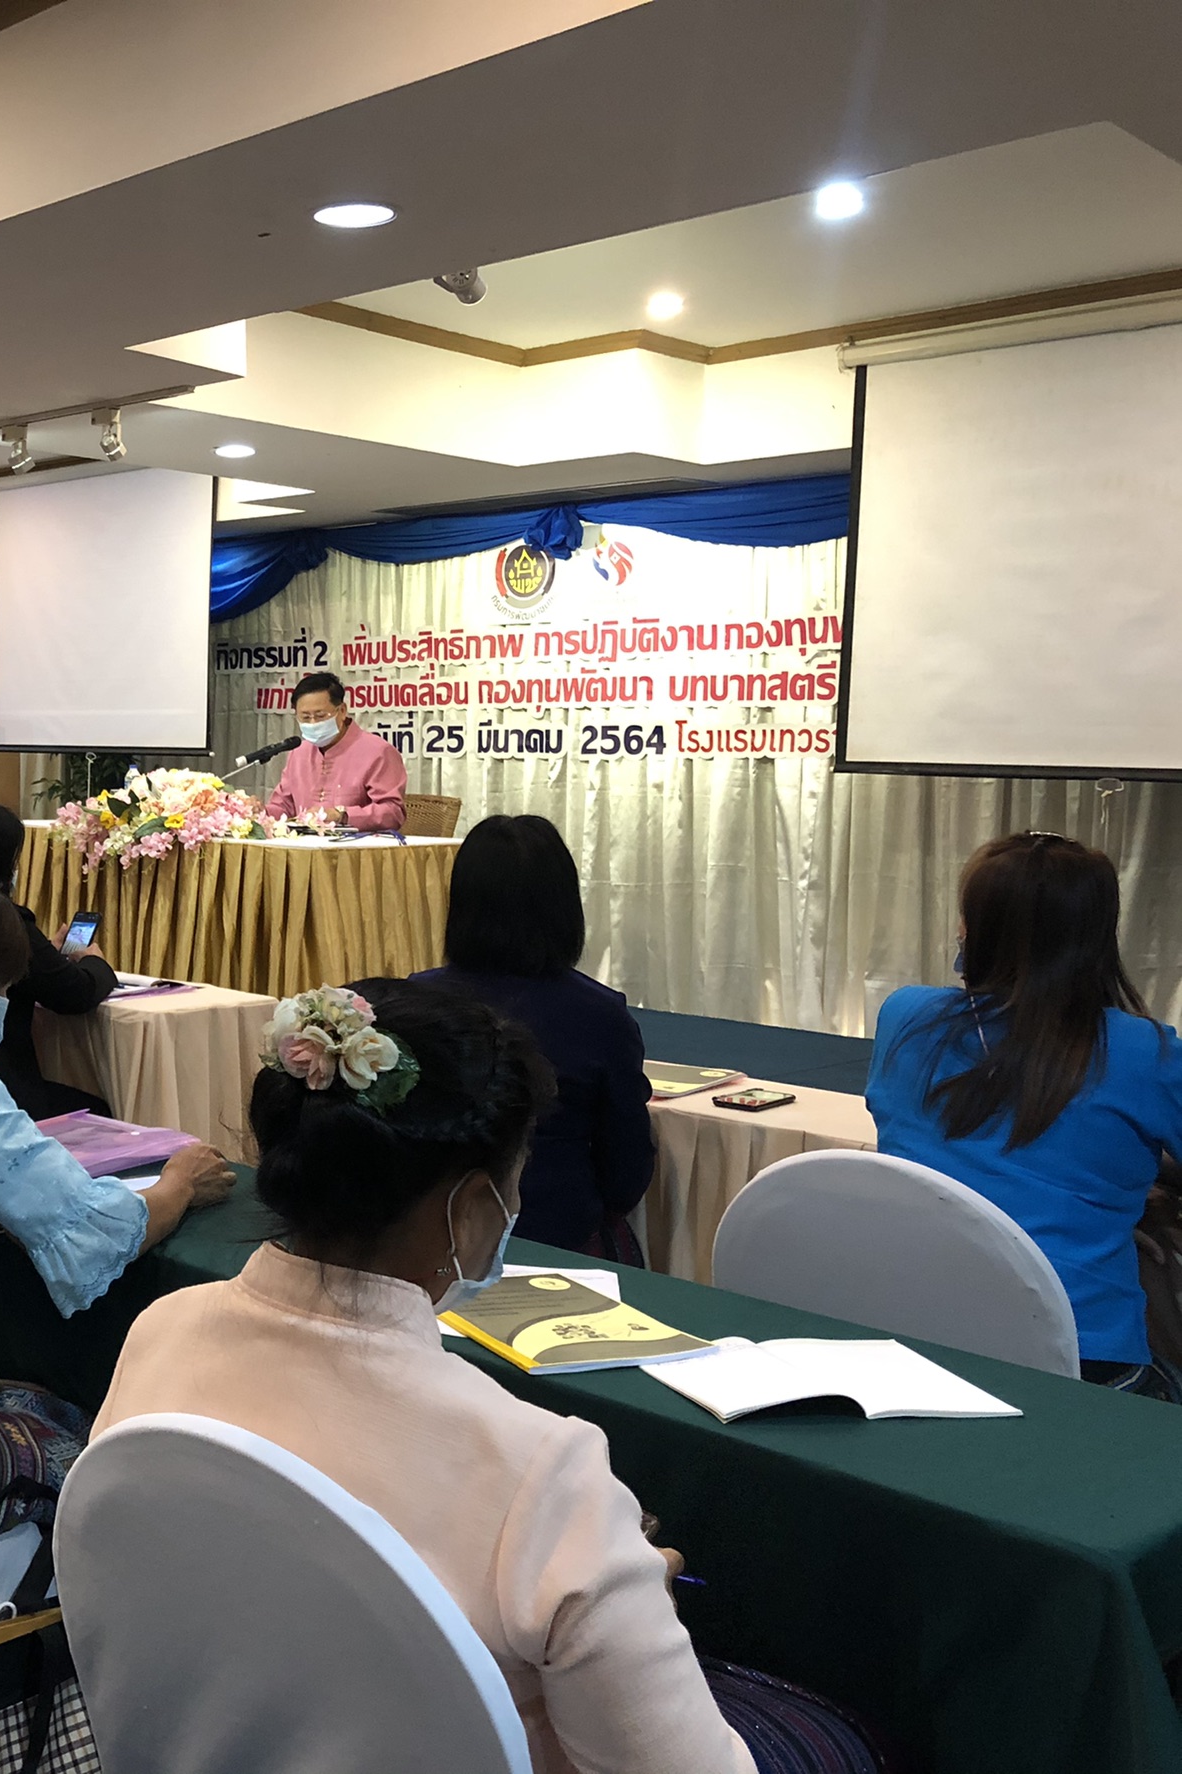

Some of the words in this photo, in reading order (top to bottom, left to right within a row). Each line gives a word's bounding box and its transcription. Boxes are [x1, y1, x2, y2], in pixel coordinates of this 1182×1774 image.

[216, 627, 308, 671] กิจกรรมที่
[313, 640, 328, 667] 2
[343, 624, 524, 667] เพิ่มประสิทธิภาพ
[478, 667, 654, 713] กองทุนพัฒนา
[669, 660, 837, 702] บทบาทสตรี
[371, 711, 414, 754] ันที่
[426, 725, 465, 754] 25
[477, 719, 563, 754] มีนาคม
[581, 725, 667, 755] 2564
[675, 720, 837, 754] โรงแรมเทวร
